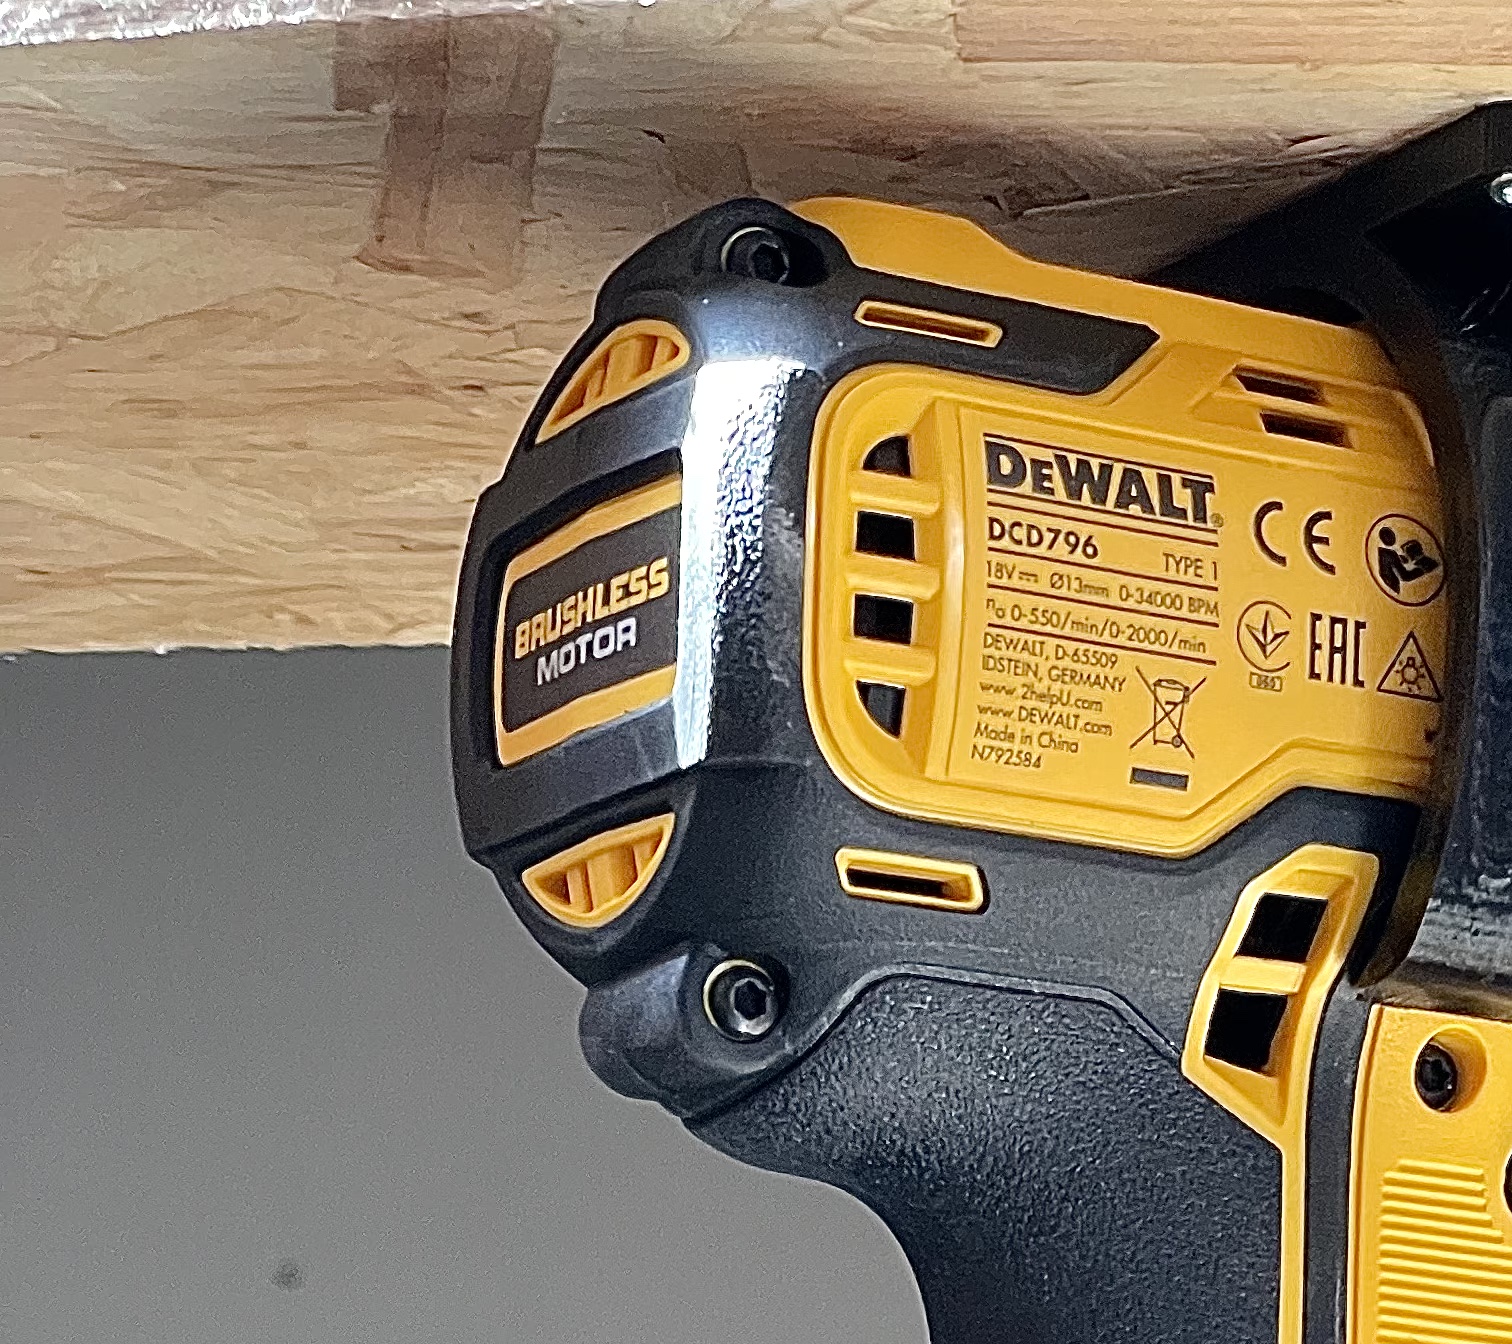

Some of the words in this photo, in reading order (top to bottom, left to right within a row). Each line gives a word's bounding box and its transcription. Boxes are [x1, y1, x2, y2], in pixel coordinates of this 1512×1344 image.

[988, 516, 1099, 560] DCD796
[1162, 552, 1203, 579] TYPE
[1254, 501, 1336, 575] CE
[515, 557, 670, 659] BRUSHLESS
[1187, 596, 1220, 619] BPM
[537, 617, 637, 686] MOTOR
[983, 632, 1050, 661] DEWALT,
[1054, 644, 1119, 669] D-65509
[982, 655, 1043, 683] IDSTEIN,
[1047, 665, 1127, 692] GERMANY
[973, 721, 1016, 744] Made
[1019, 727, 1033, 746] in
[1037, 731, 1079, 753] China
[977, 704, 1113, 736] www.DEWALT.com
[971, 744, 1042, 769] N792584
